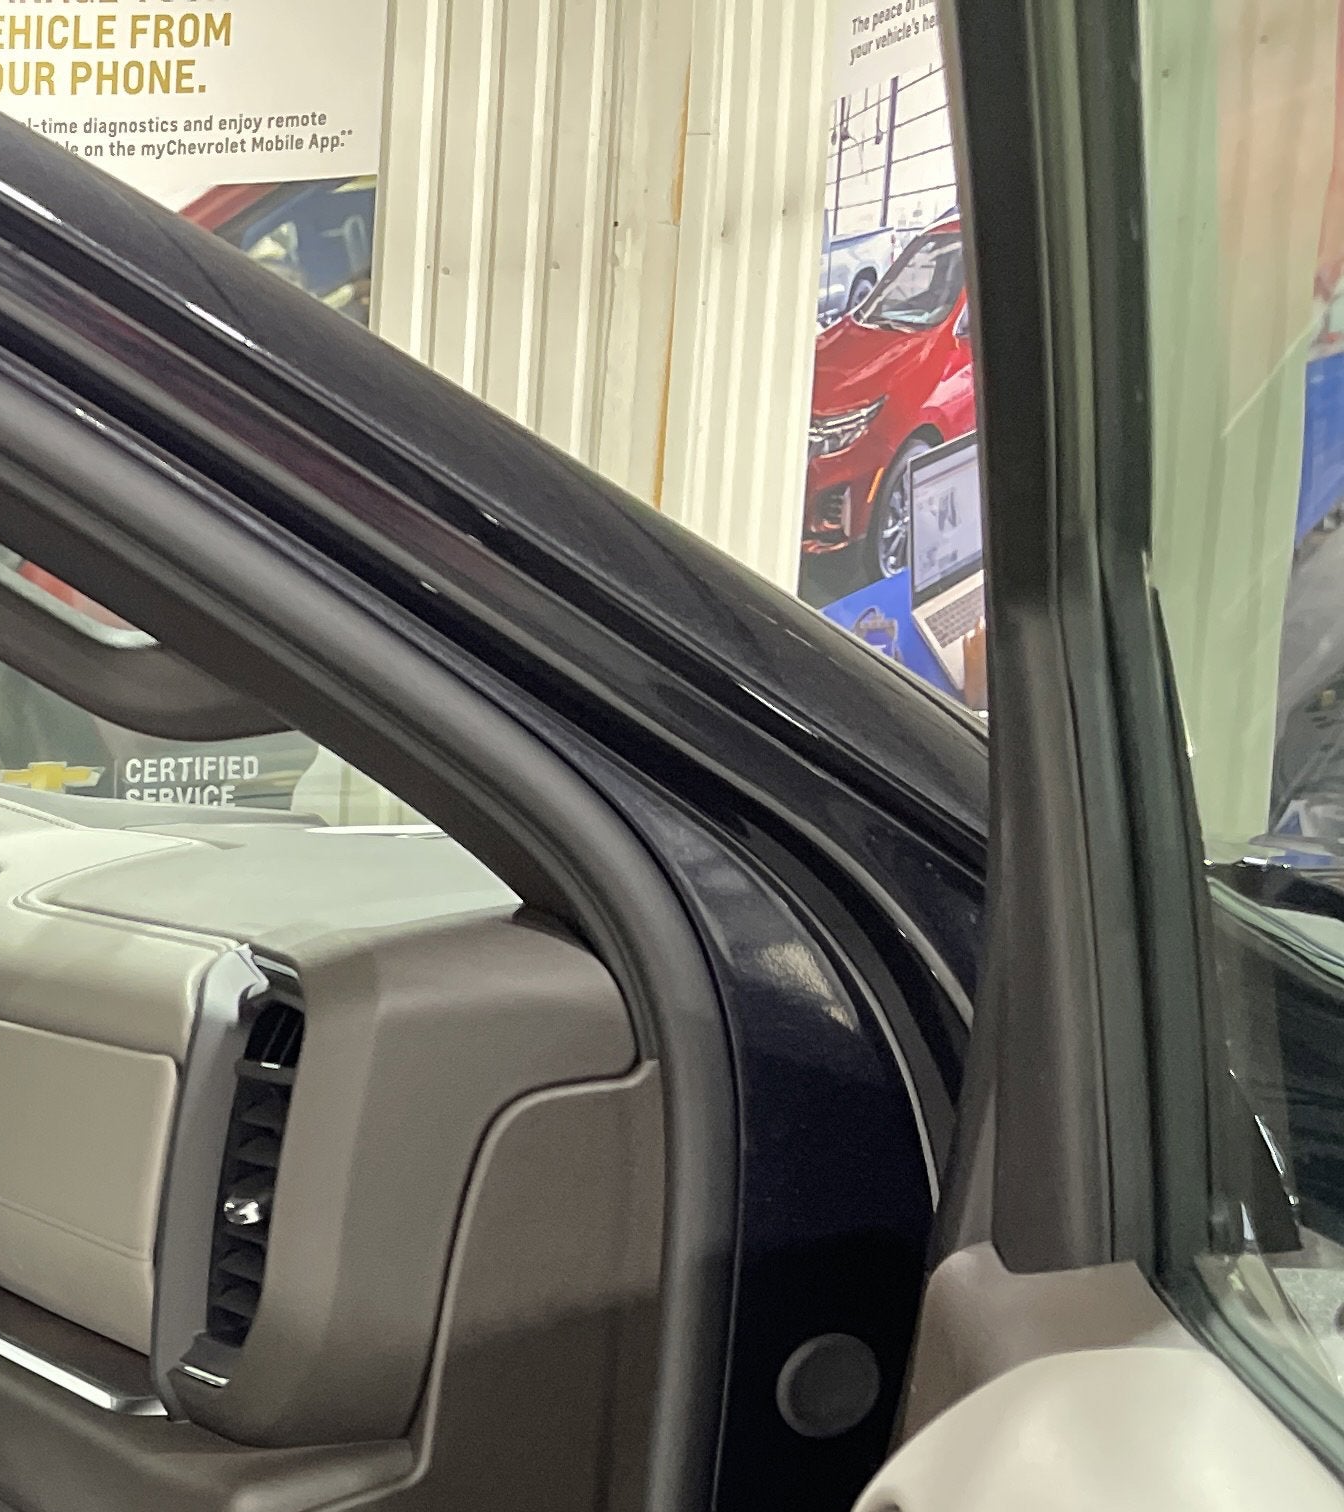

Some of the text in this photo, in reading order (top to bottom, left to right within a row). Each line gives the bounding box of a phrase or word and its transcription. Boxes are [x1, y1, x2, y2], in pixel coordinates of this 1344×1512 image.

[130, 12, 232, 48] FROM
[852, 16, 870, 35] The
[872, 3, 903, 31] peace
[850, 40, 873, 65] your
[876, 17, 919, 50] vehicle's
[70, 59, 206, 95] PHONE.
[83, 116, 178, 138] diagnostics
[183, 115, 213, 132] and
[218, 113, 263, 134] enjoy
[267, 111, 327, 129] remote
[84, 144, 104, 157] on
[109, 140, 136, 157] the
[141, 137, 247, 160] myChevrolet
[251, 134, 304, 153] Mobile
[125, 755, 259, 783] CERTIFIED
